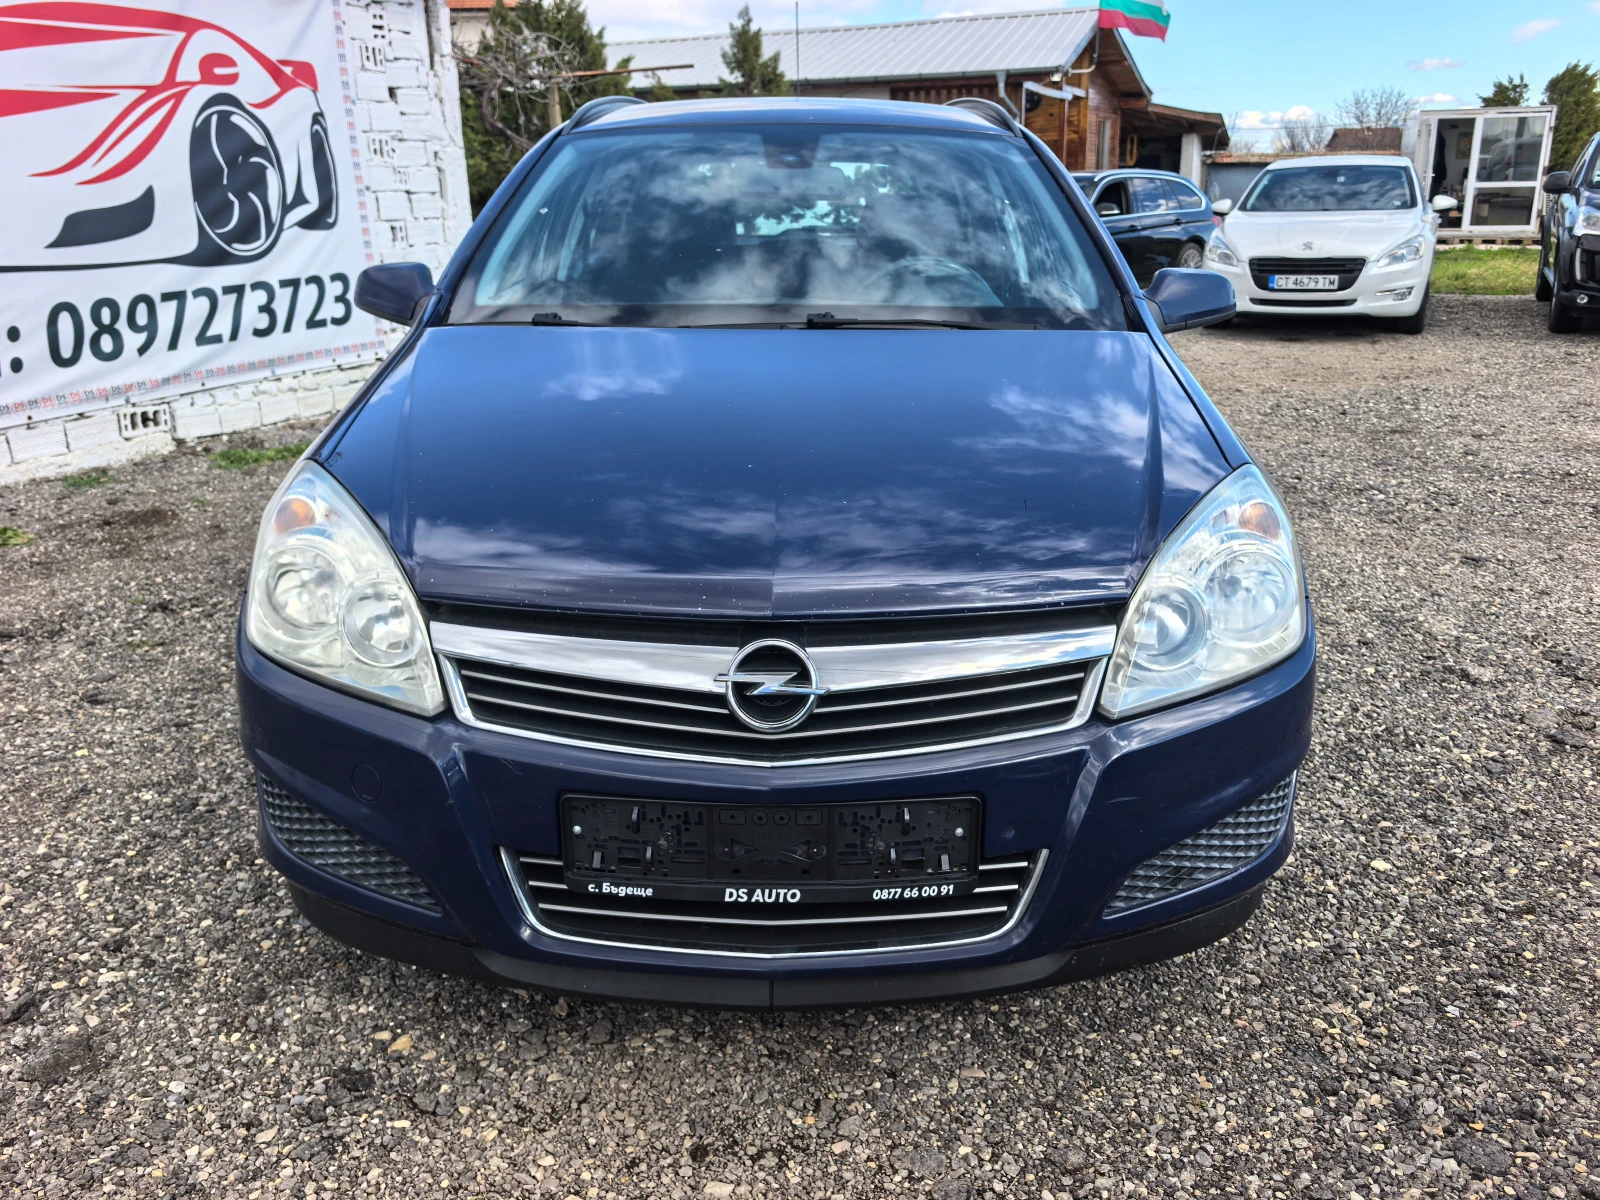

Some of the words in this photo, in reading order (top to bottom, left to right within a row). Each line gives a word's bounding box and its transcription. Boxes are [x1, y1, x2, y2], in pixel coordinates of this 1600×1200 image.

[1276, 277, 1290, 288] CT
[1292, 276, 1319, 288] 4679
[1321, 276, 1336, 288] TM
[46, 272, 353, 369] 0897273723
[587, 883, 599, 893] с.
[602, 882, 654, 898] Бъдеще
[724, 887, 749, 903] DS
[750, 888, 801, 903] AUTO
[872, 887, 903, 900] 0877
[903, 886, 919, 899] 66
[921, 885, 939, 898] 00
[940, 884, 954, 896] 91
